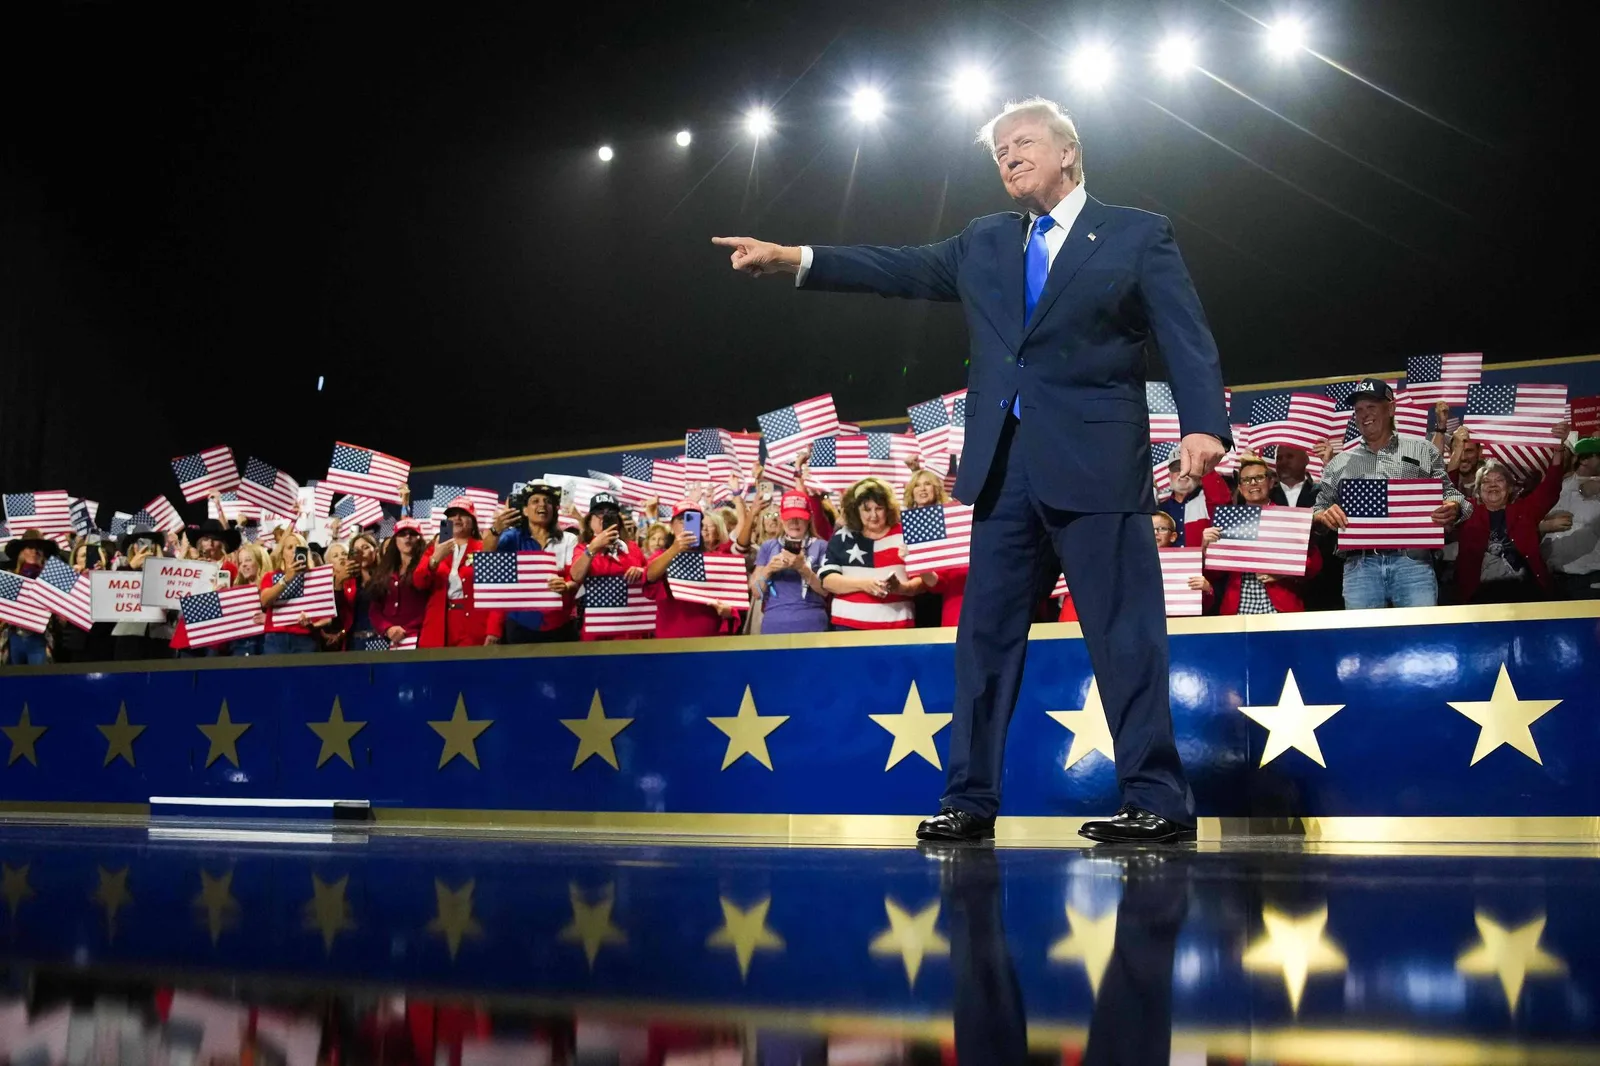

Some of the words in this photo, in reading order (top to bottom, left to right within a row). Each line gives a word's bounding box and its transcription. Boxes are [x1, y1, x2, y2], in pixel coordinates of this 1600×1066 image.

[596, 494, 614, 502] USA
[160, 566, 202, 579] MADE
[108, 580, 141, 590] MAD
[165, 590, 192, 599] USA
[116, 602, 142, 612] USA
